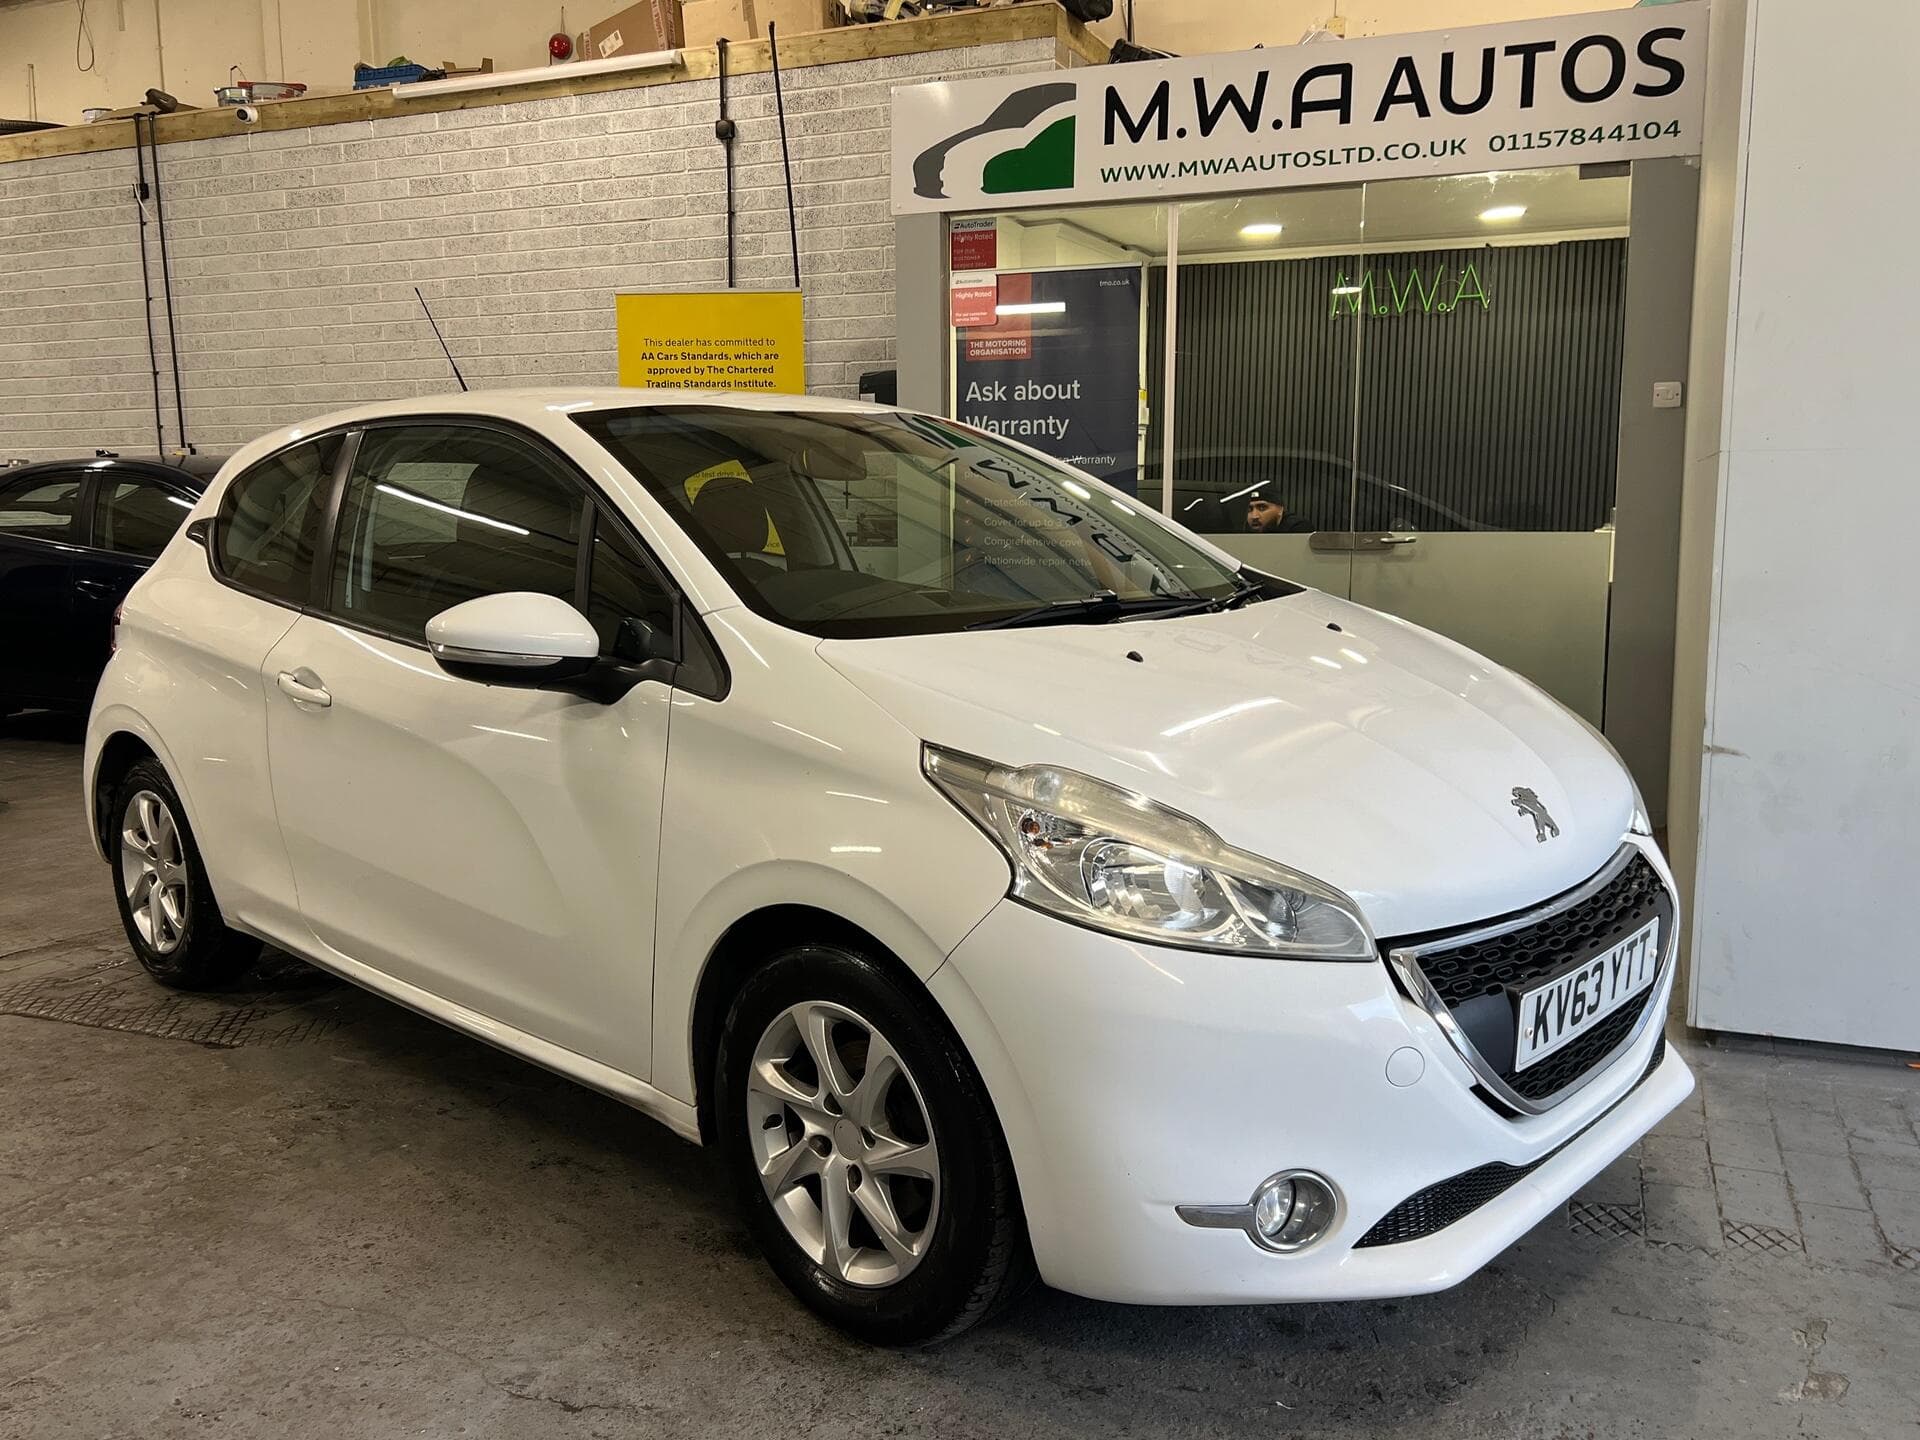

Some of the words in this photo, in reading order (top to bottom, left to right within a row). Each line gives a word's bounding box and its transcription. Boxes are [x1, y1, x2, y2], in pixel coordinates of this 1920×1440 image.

[1103, 61, 1354, 146] M.W.A
[1373, 26, 1687, 122] AUTOS
[1100, 137, 1467, 183] WWW.MWAAUTOSLTD.CO.UK
[1488, 118, 1682, 153] 01157844104
[955, 291, 973, 300] Highly
[975, 290, 992, 298] Rated
[1331, 263, 1488, 319] M.W.A
[644, 338, 663, 347] This
[665, 338, 693, 347] dealer
[696, 338, 712, 347] has
[714, 337, 764, 347] committed
[765, 338, 775, 346] to
[970, 340, 984, 348] THE
[985, 339, 1026, 348] MOTORING
[641, 352, 655, 361] AA
[656, 352, 679, 361] Cars
[680, 351, 732, 362] Standards,
[733, 351, 763, 361] which
[764, 353, 779, 361] are
[969, 346, 1027, 357] ORGANISATION
[647, 366, 692, 375] approved
[694, 366, 705, 375] by
[707, 365, 724, 374] The
[727, 365, 774, 374] Chartered
[646, 379, 681, 388] Trading
[683, 379, 732, 388] Standards
[734, 379, 777, 388] Institute.
[965, 381, 1008, 402] Ask
[1013, 379, 1081, 401] about
[965, 415, 1070, 440] Warranty
[1072, 455, 1116, 466] Warranty
[1030, 519, 1041, 528] up
[984, 554, 1036, 565] Nationwide
[1039, 556, 1065, 567] repair
[1531, 960, 1605, 1051] KV63
[1611, 927, 1651, 1000] YTT
